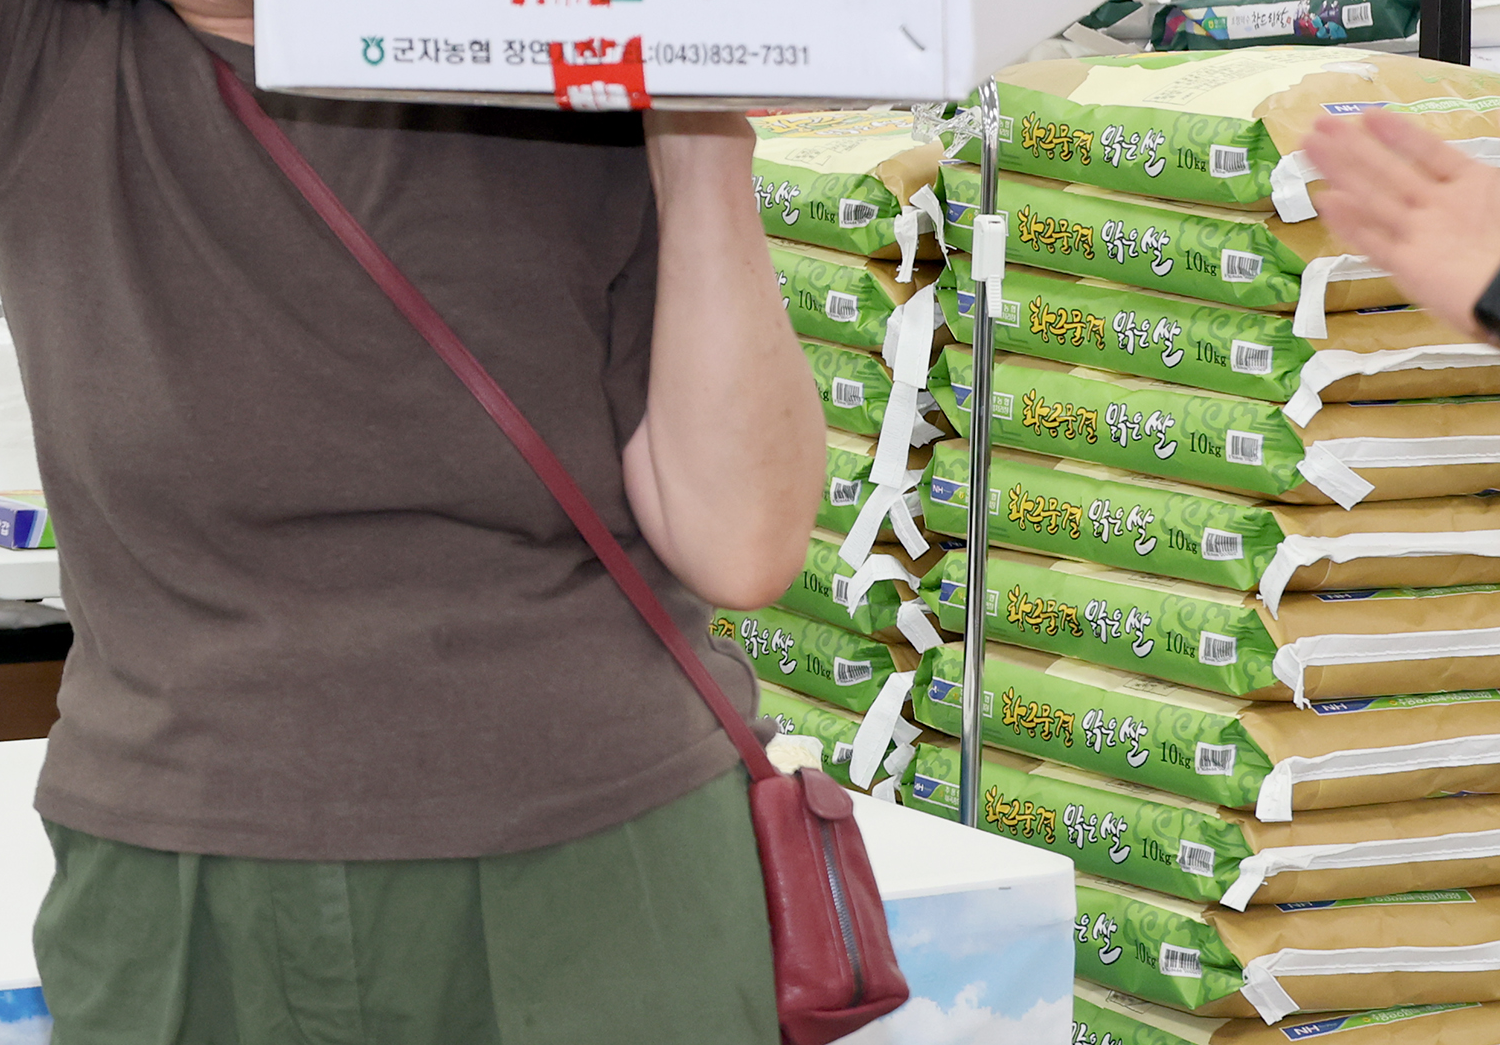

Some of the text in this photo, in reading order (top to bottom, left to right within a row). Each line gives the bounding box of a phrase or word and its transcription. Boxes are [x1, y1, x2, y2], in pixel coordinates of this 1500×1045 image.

[392, 38, 491, 65] 군자농협
[1336, 104, 1360, 112] NH
[1021, 111, 1094, 166] 황금물결
[1177, 147, 1207, 172] 10kg
[809, 200, 836, 224] 10kg
[1018, 204, 1095, 260] 황금물결
[1185, 249, 1217, 277] 10kg
[1028, 295, 1106, 350] 황금물결
[1195, 340, 1227, 367] 10kg
[1022, 388, 1098, 444] 황금물결
[1189, 431, 1222, 458] 10kg
[932, 484, 944, 494] NH
[1007, 483, 1083, 539] 황금물결
[1168, 528, 1197, 555] 10kg
[803, 571, 830, 597] 10kg
[1007, 584, 1083, 637] 황금물결
[1165, 630, 1196, 658] 10kg
[806, 654, 831, 680] 10kg
[1001, 686, 1076, 748] 황금물결
[1159, 741, 1191, 769] 10kg
[1324, 703, 1347, 711] NH
[984, 784, 1056, 844] 황금물결
[1141, 838, 1172, 866] 10kg
[1073, 912, 1157, 969] 은쌀 10kg
[1294, 1025, 1320, 1035] NH
